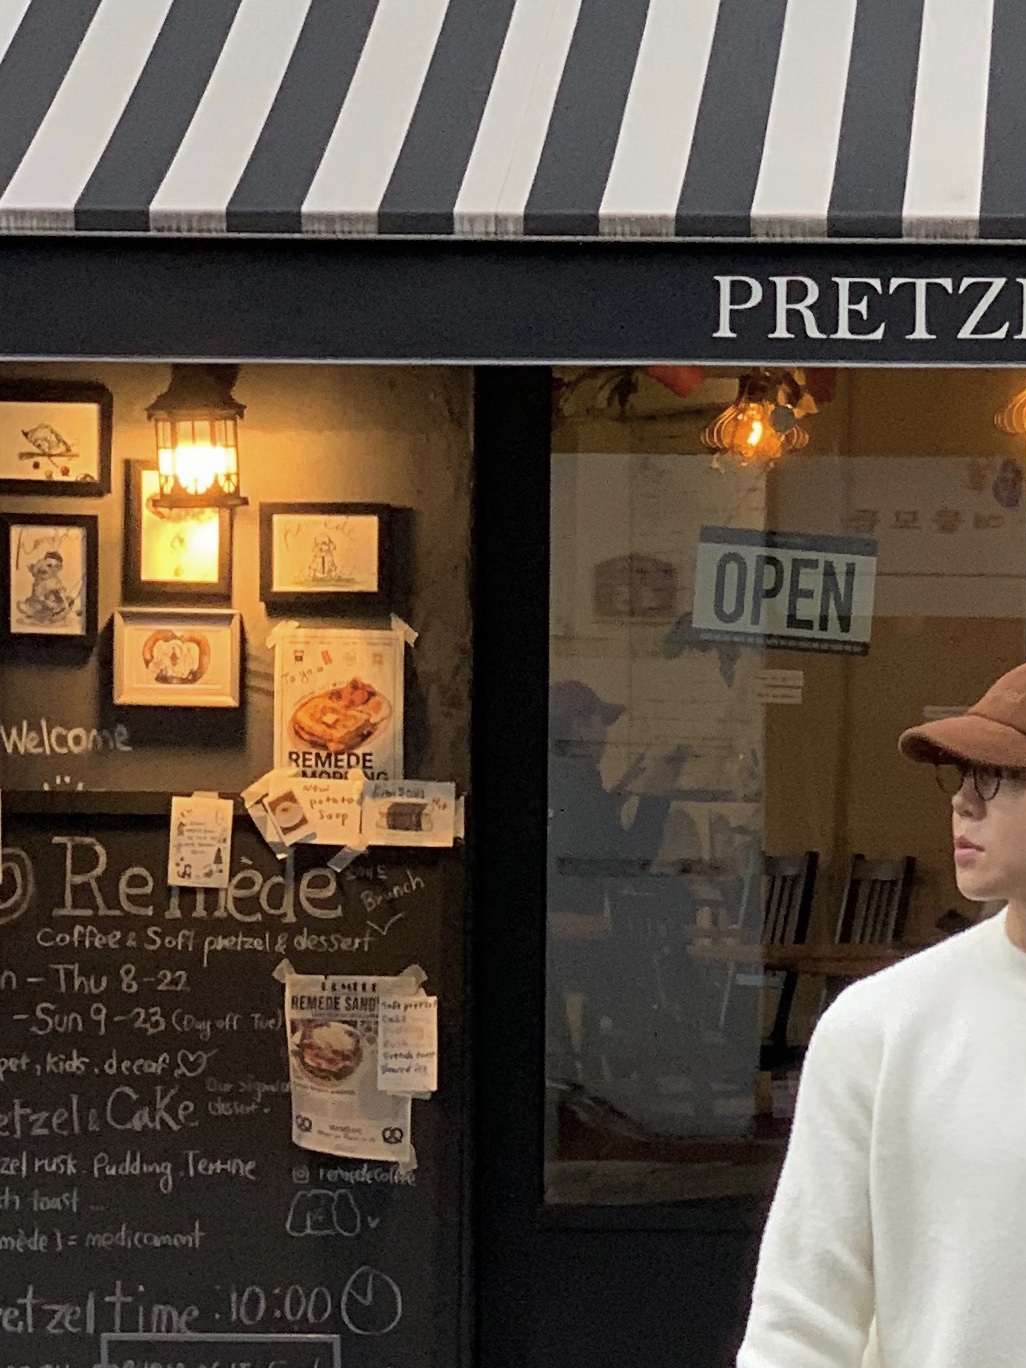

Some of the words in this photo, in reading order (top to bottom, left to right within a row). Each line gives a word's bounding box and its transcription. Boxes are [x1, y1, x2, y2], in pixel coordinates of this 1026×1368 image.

[714, 551, 856, 633] OPEN
[0, 718, 133, 755] Welcome
[288, 751, 374, 769] REMEDE
[360, 869, 425, 912] Brunch
[37, 925, 121, 948] Coffee
[104, 1280, 200, 1333] time
